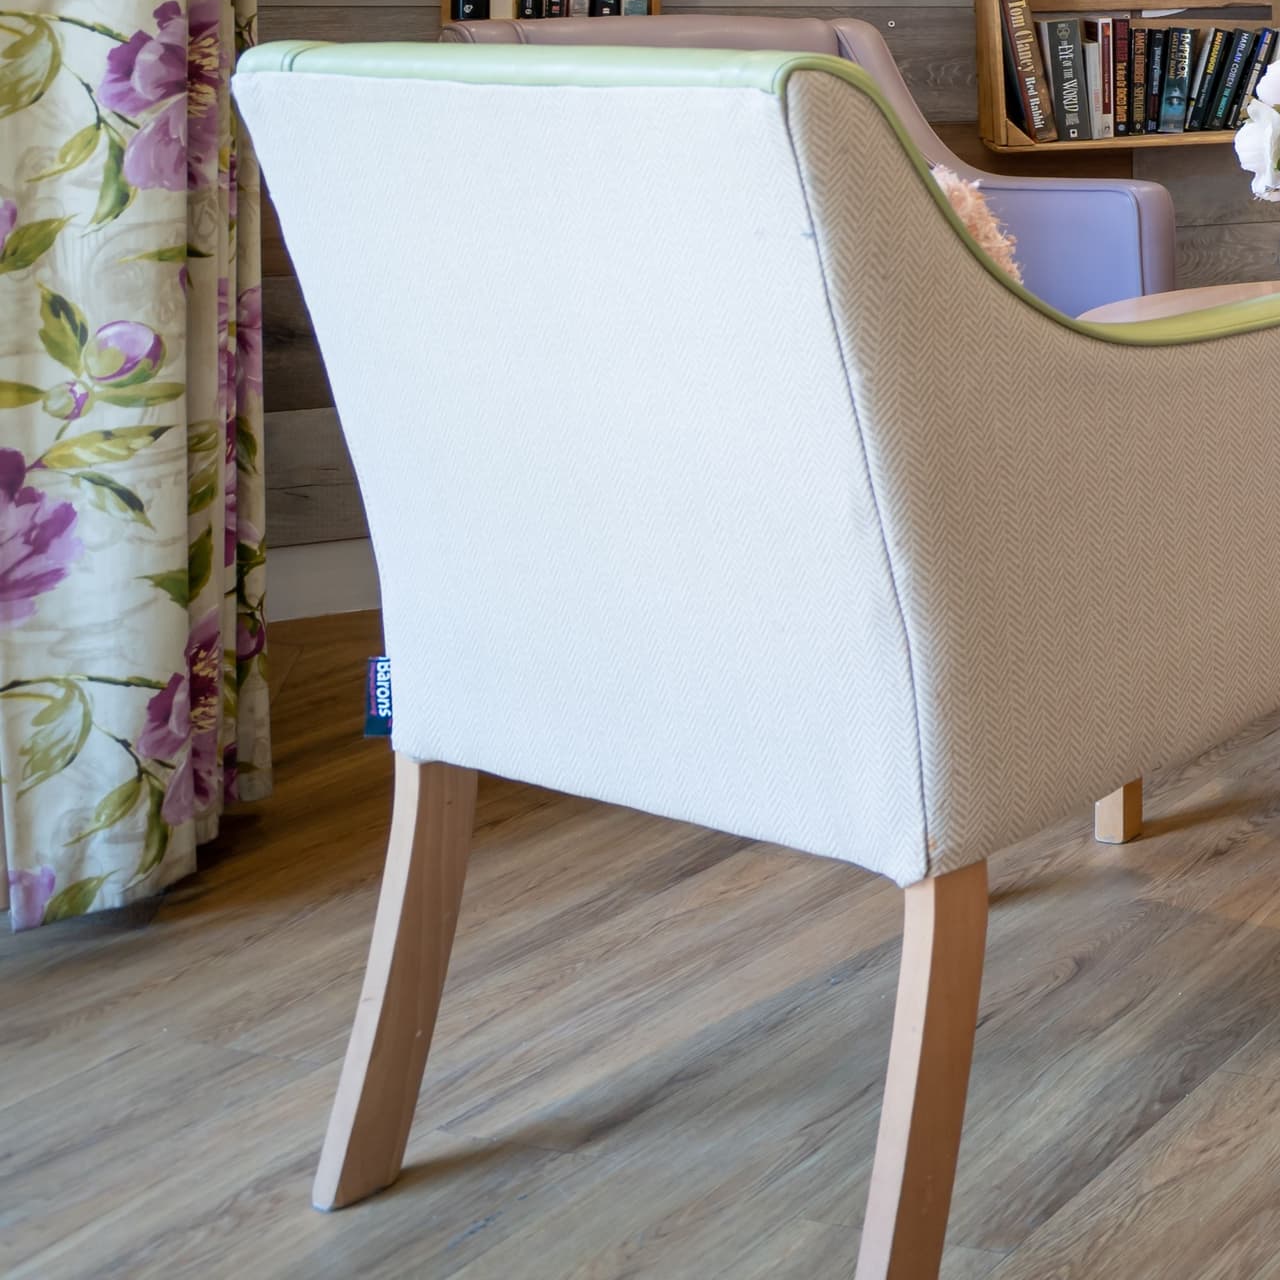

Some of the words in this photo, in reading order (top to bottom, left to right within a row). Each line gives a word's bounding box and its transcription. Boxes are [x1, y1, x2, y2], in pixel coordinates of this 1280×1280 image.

[1135, 32, 1145, 54] JAMES
[1214, 32, 1223, 45] IAN
[1233, 32, 1249, 62] HARLAN
[1014, 30, 1036, 74] Clancy
[1058, 45, 1074, 60] EYE
[1176, 33, 1191, 79] EMPEROR
[1063, 68, 1073, 79] THE
[1134, 55, 1144, 84] HERBERT
[1169, 59, 1177, 79] ROME
[1226, 63, 1239, 87] COBEN
[1025, 76, 1038, 95] Red
[1062, 80, 1079, 112] WORLD
[1027, 98, 1045, 129] Rabbit
[1134, 87, 1144, 122] SEPULCHRE
